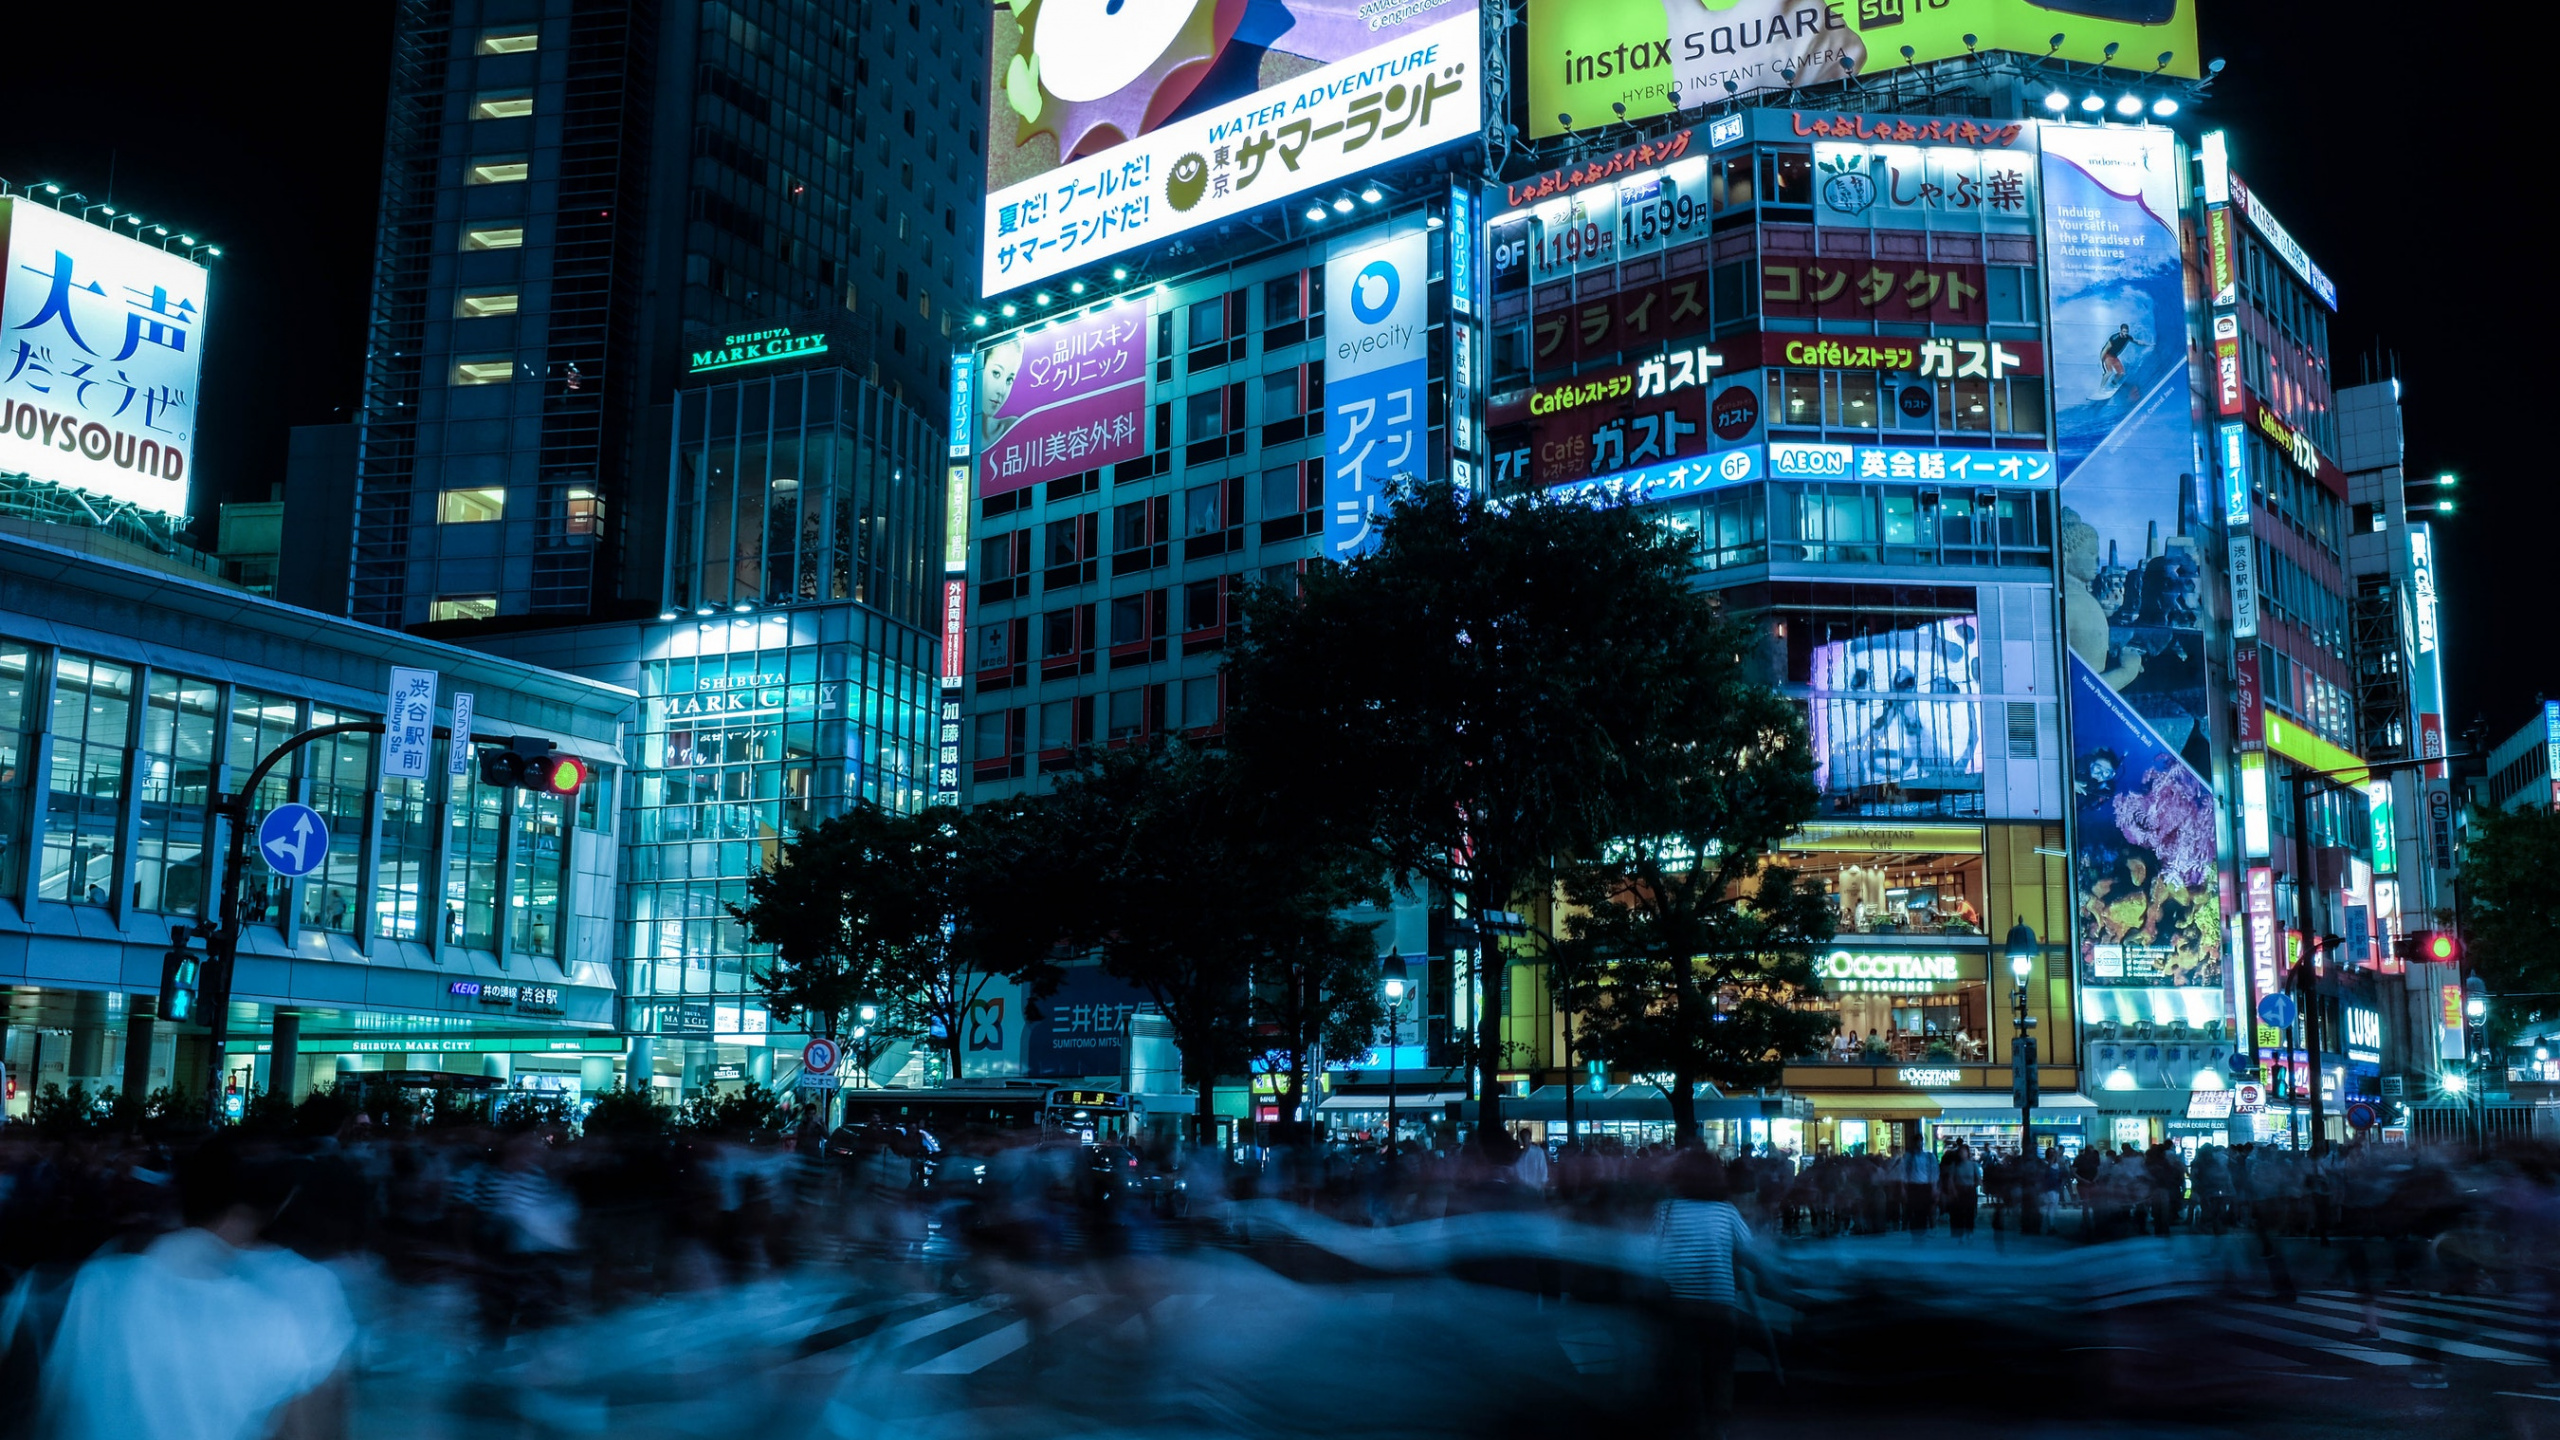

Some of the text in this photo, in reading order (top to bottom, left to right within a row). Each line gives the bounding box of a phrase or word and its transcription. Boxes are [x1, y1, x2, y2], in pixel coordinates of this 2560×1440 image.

[1564, 38, 1673, 86] instax
[1684, 2, 1846, 62] SQUARE
[1622, 47, 1848, 103] HYBRID INSTANT CAMERA
[1208, 43, 1440, 144] WATER ADVENTURE
[1235, 62, 1465, 191] サマーランド
[1793, 112, 2023, 147] しゃぶしゃぶバイキング
[1211, 145, 1231, 200] 東京
[1507, 129, 1693, 207] しゃぶしゃぶバイキング
[997, 154, 1151, 237] 夏だ！ プールだ！
[1891, 167, 2025, 212] しゃぶ葉
[2057, 206, 2101, 221] Indulge
[2057, 219, 2120, 232] Yourself in
[997, 195, 1150, 274] サマーランドだ！
[1454, 203, 1467, 293] 東急リバブル
[2059, 232, 2146, 246] the Paradise of
[1495, 240, 1526, 270] 9F
[2059, 246, 2126, 259] Adventures
[1455, 299, 1467, 308] 9F
[1764, 266, 1978, 310] コンタクト
[2221, 294, 2234, 304] 8F
[10, 249, 198, 362] 大声
[1536, 280, 1704, 358] プライス
[691, 333, 826, 367] MARK CITY
[725, 327, 791, 345] SHIBUYA
[1052, 319, 1139, 366] 品川スキン
[1338, 324, 1414, 363] eyecity
[1052, 349, 1128, 392] クリニック
[1786, 337, 2021, 380] Caféレストラン ガスト
[4, 339, 188, 441] だそうぜ。
[1456, 354, 1467, 434] 献血ルーム
[1530, 345, 1723, 415] Caféレストラン ガスト
[2221, 357, 2238, 406] ガスト
[955, 367, 968, 441] 東急リバブル
[1718, 409, 1754, 428] ガスト
[1904, 398, 1929, 410] ガスト
[0, 397, 184, 482] JOYSOUND
[953, 446, 966, 455] 9F
[1002, 412, 1136, 478] 品川美容外科
[1541, 434, 1585, 463] Café
[1591, 410, 1696, 473] ガスト
[2292, 430, 2320, 478] ガスト
[1494, 448, 1532, 482] 7F
[1543, 457, 1585, 479] レストラン
[1723, 455, 1748, 476] 6F
[1779, 450, 1842, 471] AEON
[1861, 450, 2051, 481] 英会話イーオン
[2232, 516, 2244, 525] 6F
[2233, 545, 2251, 630] 渋谷駅前ビル
[947, 583, 962, 633] 外貨両替
[2237, 650, 2257, 662] 5F
[700, 672, 785, 690] SHIBUYA
[946, 678, 958, 687] 7F
[661, 693, 746, 715] MARK
[2238, 688, 2252, 736] Fiesta
[389, 690, 407, 757] Shibuya Sta.
[402, 678, 430, 770] 渋谷駅前
[452, 697, 468, 771] スクランブル式
[940, 702, 960, 787] 加藤眼科
[2140, 734, 2153, 748] Bali
[2425, 729, 2440, 758] 免税
[940, 794, 957, 805] 5F
[2431, 791, 2449, 818] OS
[1847, 827, 1915, 842] L'OCCITANE
[1869, 839, 1893, 851] Café
[1815, 951, 1958, 979] L'OCCITANE
[451, 982, 559, 1005] KEIO 井の頭線 渋谷駅
[1838, 980, 1934, 993] EN PROVENCE
[663, 1014, 691, 1025] MAK
[691, 1016, 708, 1025] CIT
[2347, 1006, 2380, 1049] LUSH
[352, 1041, 471, 1051] SHIBUYA MARK CITY
[1052, 1036, 1122, 1049] SUMITOMO MITSU
[803, 1077, 832, 1086] ここまで
[1899, 1068, 1961, 1082] L'OCCITANE
